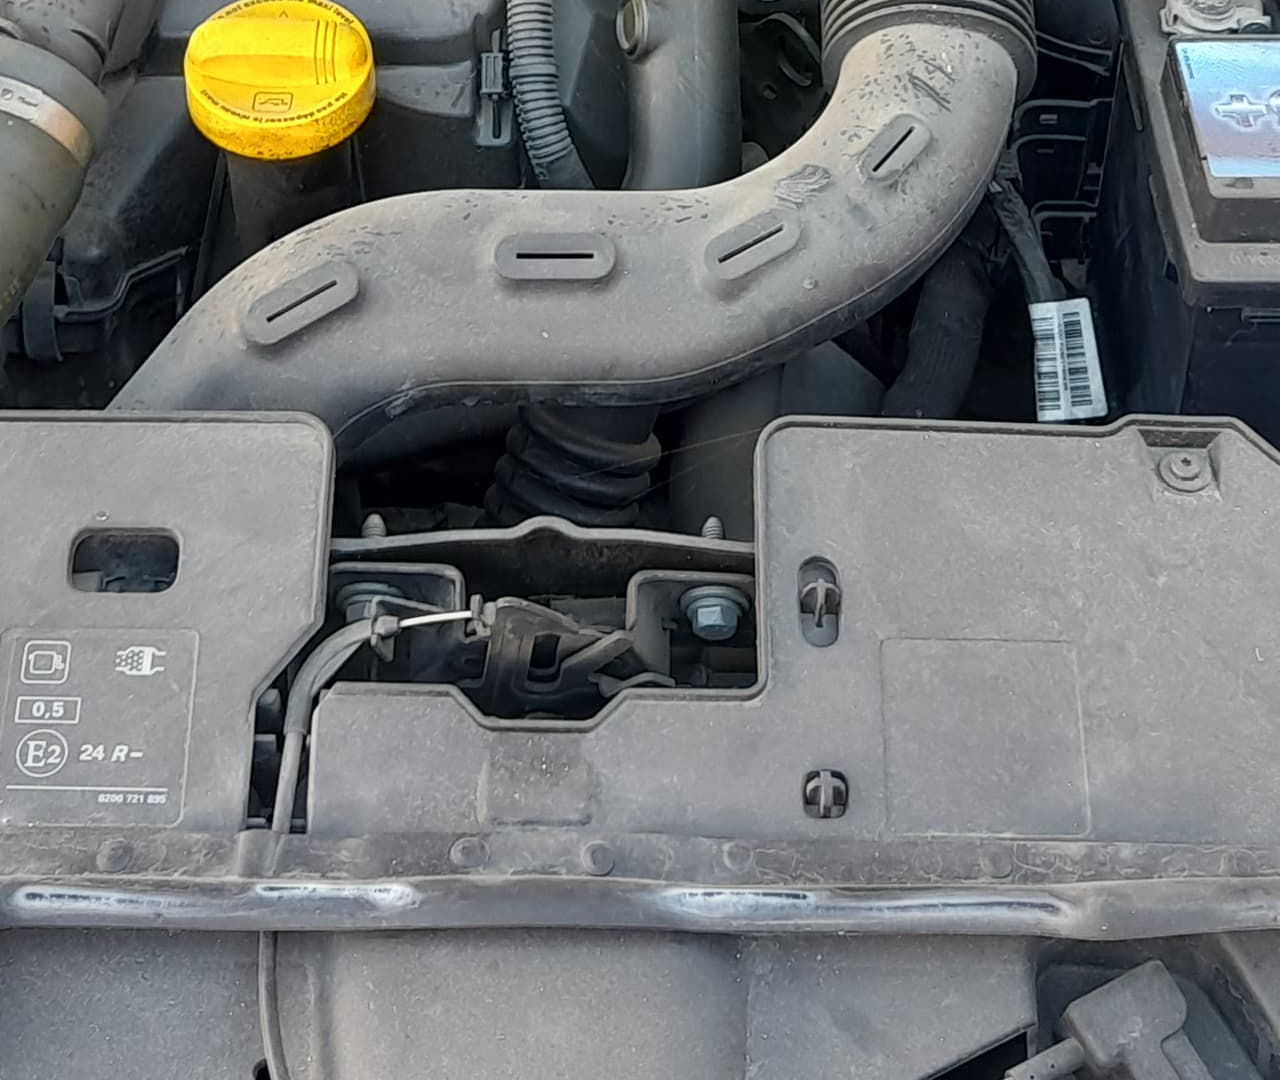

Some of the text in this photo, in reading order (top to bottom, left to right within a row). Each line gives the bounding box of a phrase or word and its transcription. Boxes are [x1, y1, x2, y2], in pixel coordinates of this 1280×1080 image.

[225, 4, 242, 18] not
[333, 8, 355, 26] level
[32, 701, 64, 719] 0,5
[24, 740, 62, 768] E2
[79, 744, 105, 761] 24
[126, 794, 145, 804] 721
